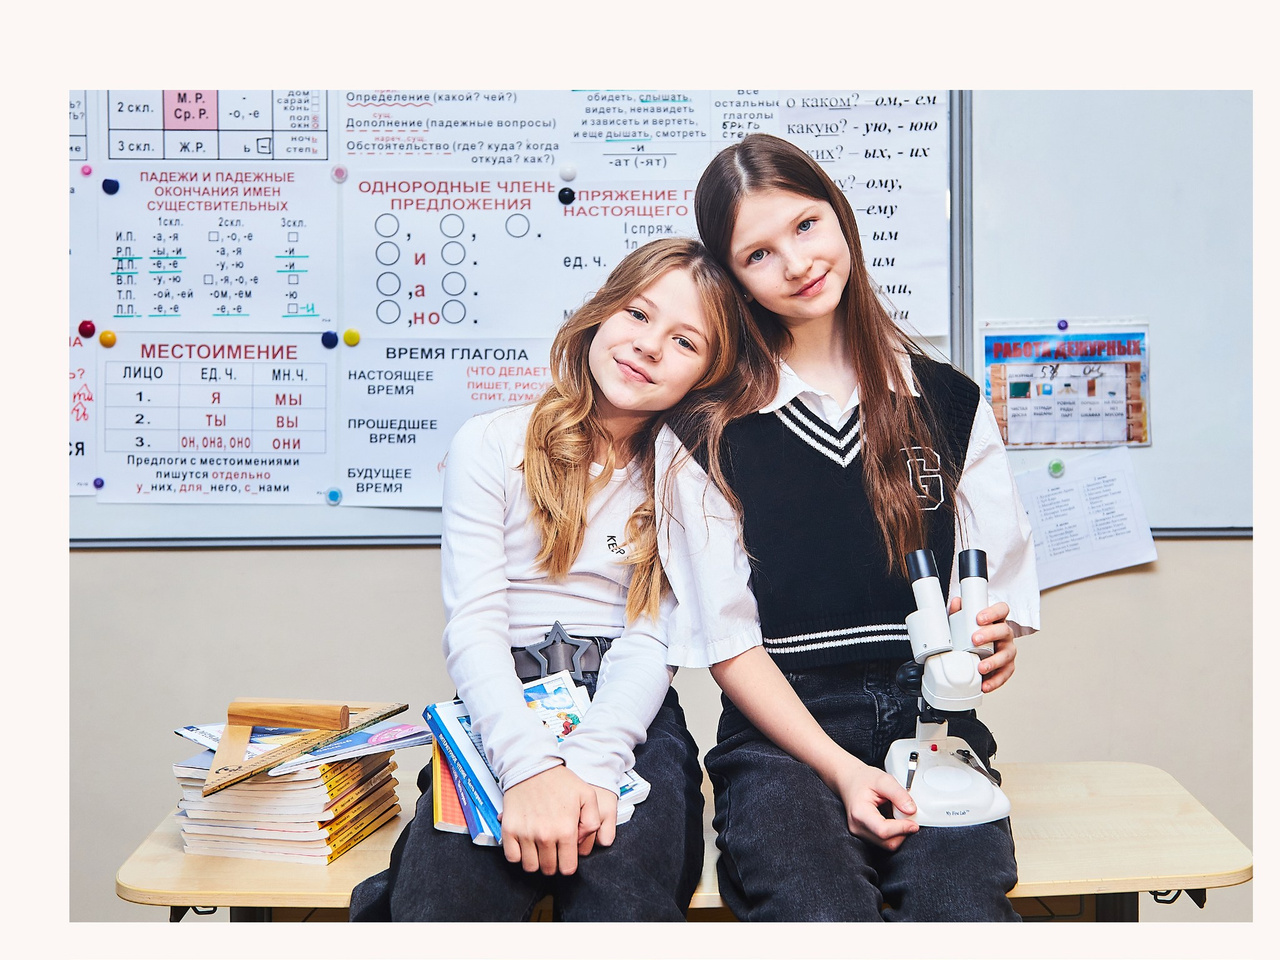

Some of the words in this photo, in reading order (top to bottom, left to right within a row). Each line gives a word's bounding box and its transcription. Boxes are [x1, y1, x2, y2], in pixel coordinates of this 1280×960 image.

[346, 92, 430, 103] Определение
[433, 92, 479, 103] (какой?
[483, 92, 517, 103] чей?)
[587, 94, 637, 102] обидеть,
[639, 94, 692, 102] слышать,
[787, 98, 795, 108] о
[802, 93, 860, 107] каком?
[127, 104, 154, 113] скл.
[585, 105, 628, 114] видеть,
[630, 106, 694, 114] ненавидеть
[174, 108, 195, 121] Ср.
[346, 118, 423, 129] Дополнение
[426, 118, 493, 129] (падежные
[497, 119, 556, 129] вопросы)
[652, 118, 698, 126] вертеть,
[787, 119, 847, 137] какую?
[862, 121, 891, 136] ую,
[909, 120, 938, 132] юю
[582, 131, 603, 139] еще
[606, 130, 652, 139] дышать,
[656, 130, 706, 138] смотреть
[128, 143, 154, 151] скл.
[346, 141, 450, 151] Обстоятельство
[453, 141, 484, 151] (где?
[487, 142, 522, 152] куда?
[526, 142, 560, 151] когда
[471, 154, 520, 164] откуда?
[523, 154, 555, 164] как?)
[864, 148, 891, 159] ых,
[909, 148, 930, 158] их
[140, 172, 198, 183] ПАДЕЖИ
[202, 172, 211, 182] И
[216, 172, 295, 184] ПАДЕЖНЫЕ
[154, 187, 239, 197] ОКОНЧАНИЯ
[243, 187, 281, 197] ИМЕН
[359, 181, 491, 195] ОДНОРОДНЫЕ
[147, 201, 288, 213] СУЩЕСТВИТЕЛЬНЫХ
[391, 198, 531, 211] ПРЕДЛОЖЕНИЯ
[564, 206, 688, 218] НАСТОЯЩЕГО
[631, 224, 677, 236] спряж.
[116, 232, 136, 241] И.П.
[117, 246, 135, 256] Р.П.
[414, 253, 426, 265] и
[563, 257, 588, 269] ед.
[872, 258, 895, 267] им
[117, 275, 137, 285] В.П.
[117, 290, 135, 300] Т.П.
[117, 305, 137, 315] П.П.
[140, 344, 298, 360] МЕСТОИМЕНИЕ
[386, 347, 445, 359] ВРЕМЯ
[451, 348, 529, 361] ГЛАГОЛА
[993, 342, 1051, 358] РАБОТА
[1055, 340, 1142, 359] ДЕЖУРНЫХ
[123, 367, 163, 381] ЛИЦО
[201, 368, 222, 382] ЕД.
[348, 370, 433, 382] НАСТОЯЩЕЕ
[467, 366, 495, 377] (ЧТО
[367, 385, 414, 395] ВРЕМЯ
[467, 381, 511, 391] ПИШЕТ,
[211, 392, 221, 404] Я
[275, 394, 302, 406] МЫ
[471, 393, 505, 401] СПИТ,
[206, 414, 226, 427] ТЫ
[276, 416, 299, 428] ВЫ
[348, 419, 438, 430] ПРОШЕДШЕЕ
[181, 437, 199, 450] он,
[202, 437, 226, 450] она,
[230, 437, 251, 448] оно
[272, 439, 301, 450] они
[369, 433, 416, 443] ВРЕМЯ
[127, 455, 187, 466] Предлоги
[200, 457, 300, 466] местоимениями
[156, 470, 209, 480] пишутся
[212, 470, 271, 480] отдельно
[347, 468, 412, 480] БУДУЩЕЕ
[356, 483, 403, 493] ВРЕМЯ
